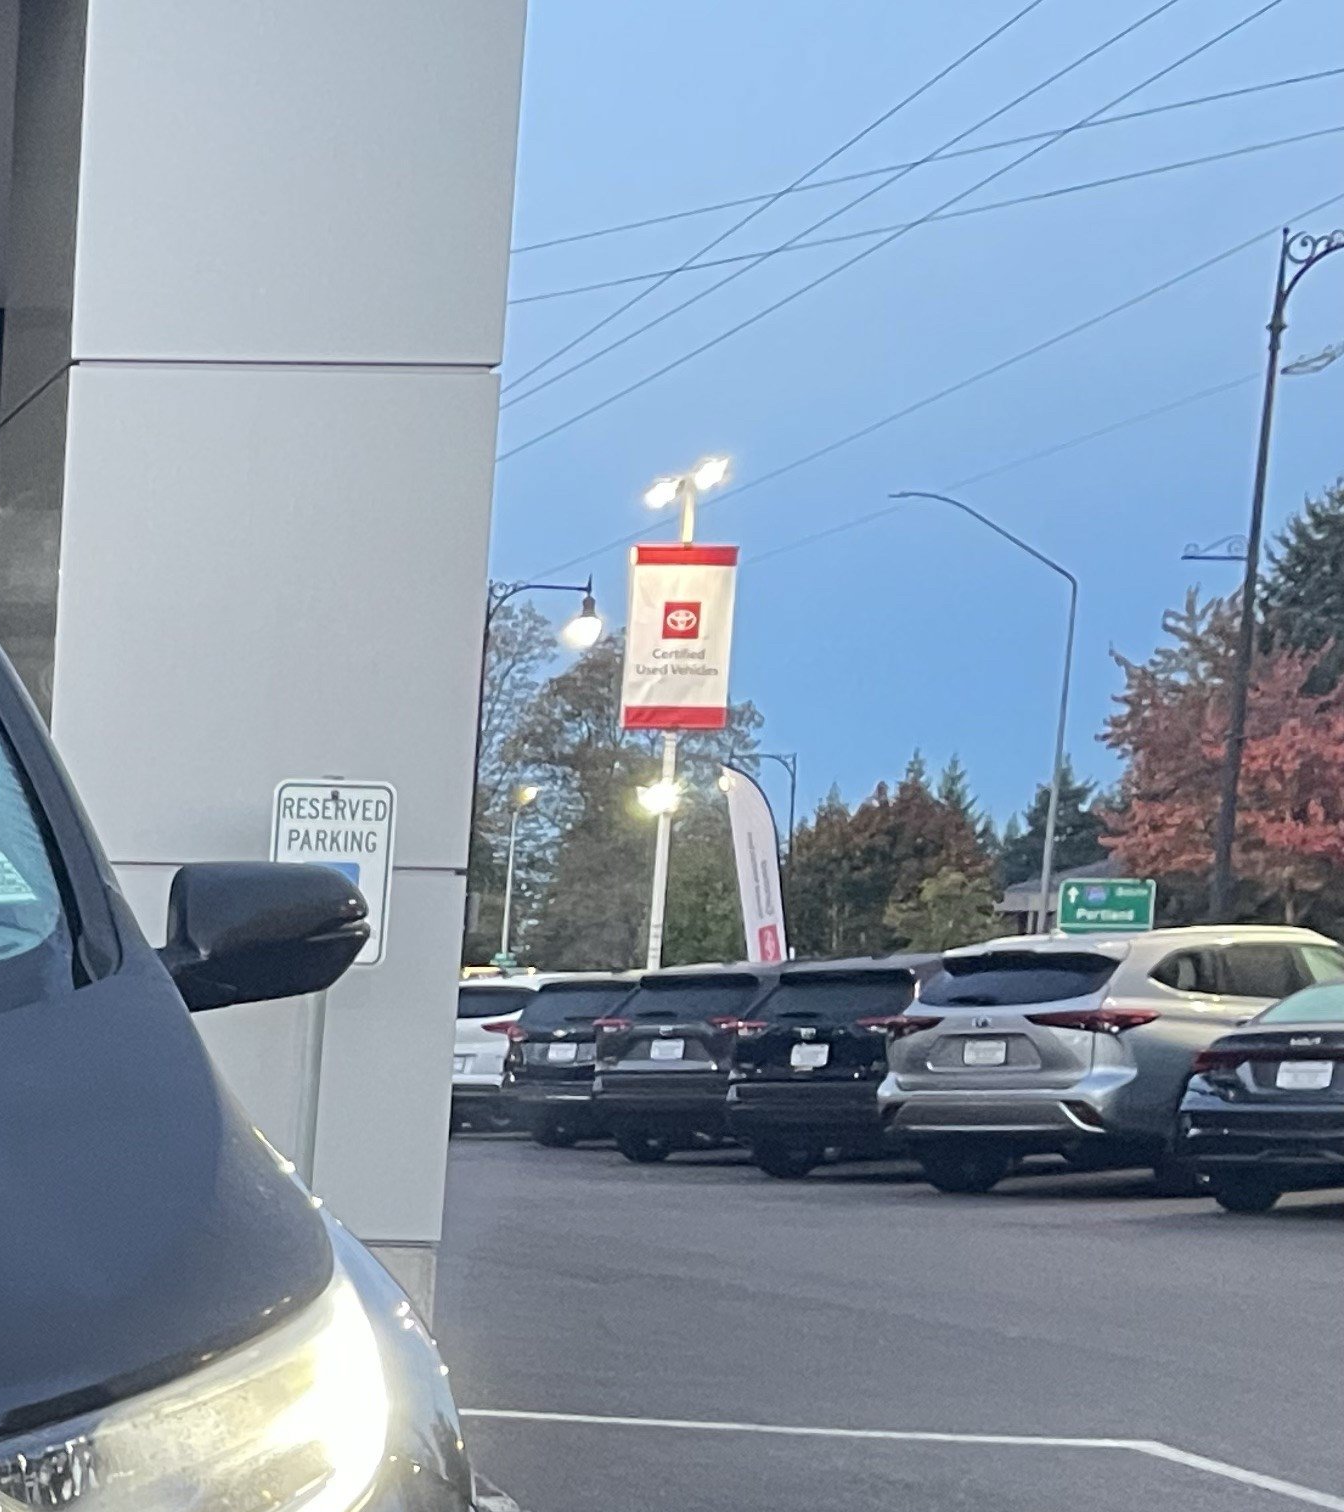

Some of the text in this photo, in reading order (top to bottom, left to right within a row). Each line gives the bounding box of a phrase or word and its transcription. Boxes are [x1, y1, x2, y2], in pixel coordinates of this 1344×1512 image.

[652, 648, 706, 660] Certified
[636, 664, 719, 676] Used Vehicles
[282, 797, 388, 822] RESERVED
[287, 829, 378, 853] PARKING
[1076, 908, 1135, 922] Portland
